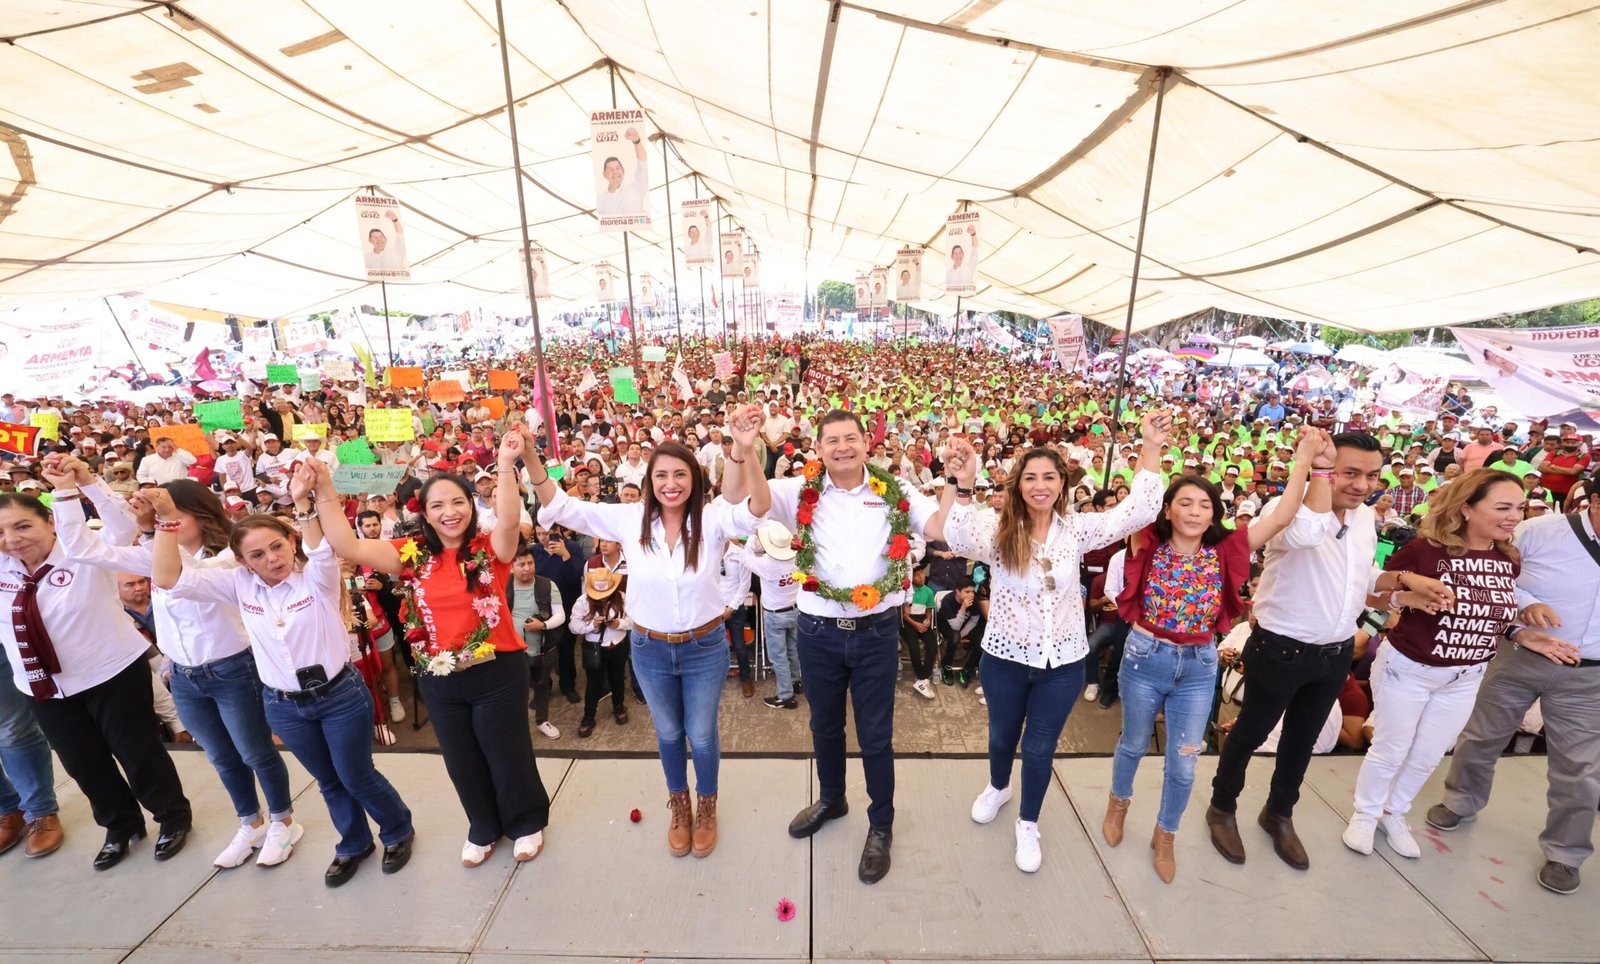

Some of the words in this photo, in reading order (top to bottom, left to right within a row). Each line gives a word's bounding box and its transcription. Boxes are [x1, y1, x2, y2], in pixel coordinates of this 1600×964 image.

[591, 110, 643, 121] ARMENTA
[355, 196, 398, 205] ARMENTA
[947, 212, 980, 221] ARMENTA
[149, 317, 179, 331] ARMENTA
[1058, 335, 1084, 345] ARMENTA
[1531, 329, 1600, 341] morena
[25, 345, 93, 365] ARMENTA
[808, 369, 844, 386] morena
[0, 430, 29, 453] PT
[350, 472, 368, 480] VALLE
[372, 472, 384, 480] SAN
[287, 595, 315, 612] ARMENTA
